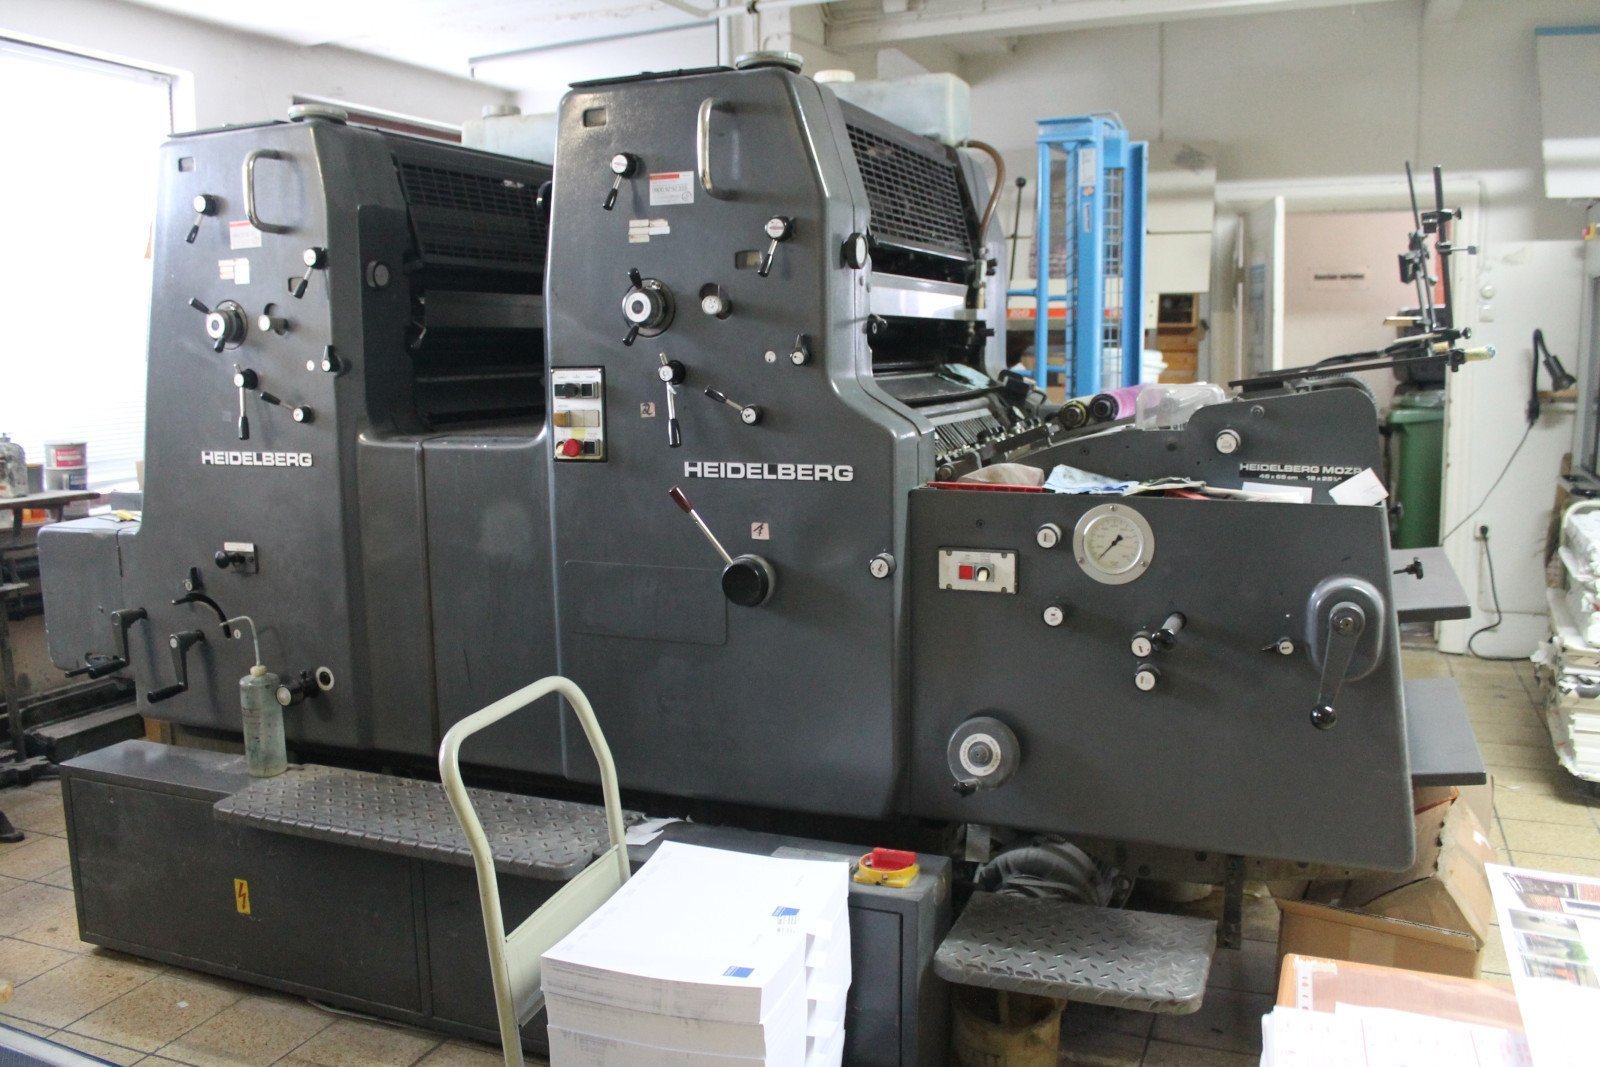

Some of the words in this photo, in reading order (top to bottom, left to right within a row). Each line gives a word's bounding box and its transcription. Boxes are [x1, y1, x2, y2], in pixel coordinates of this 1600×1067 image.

[201, 451, 313, 467] HEIDELBERG
[684, 461, 854, 482] HEIDELBERG
[1239, 463, 1320, 473] HEIDELBERG
